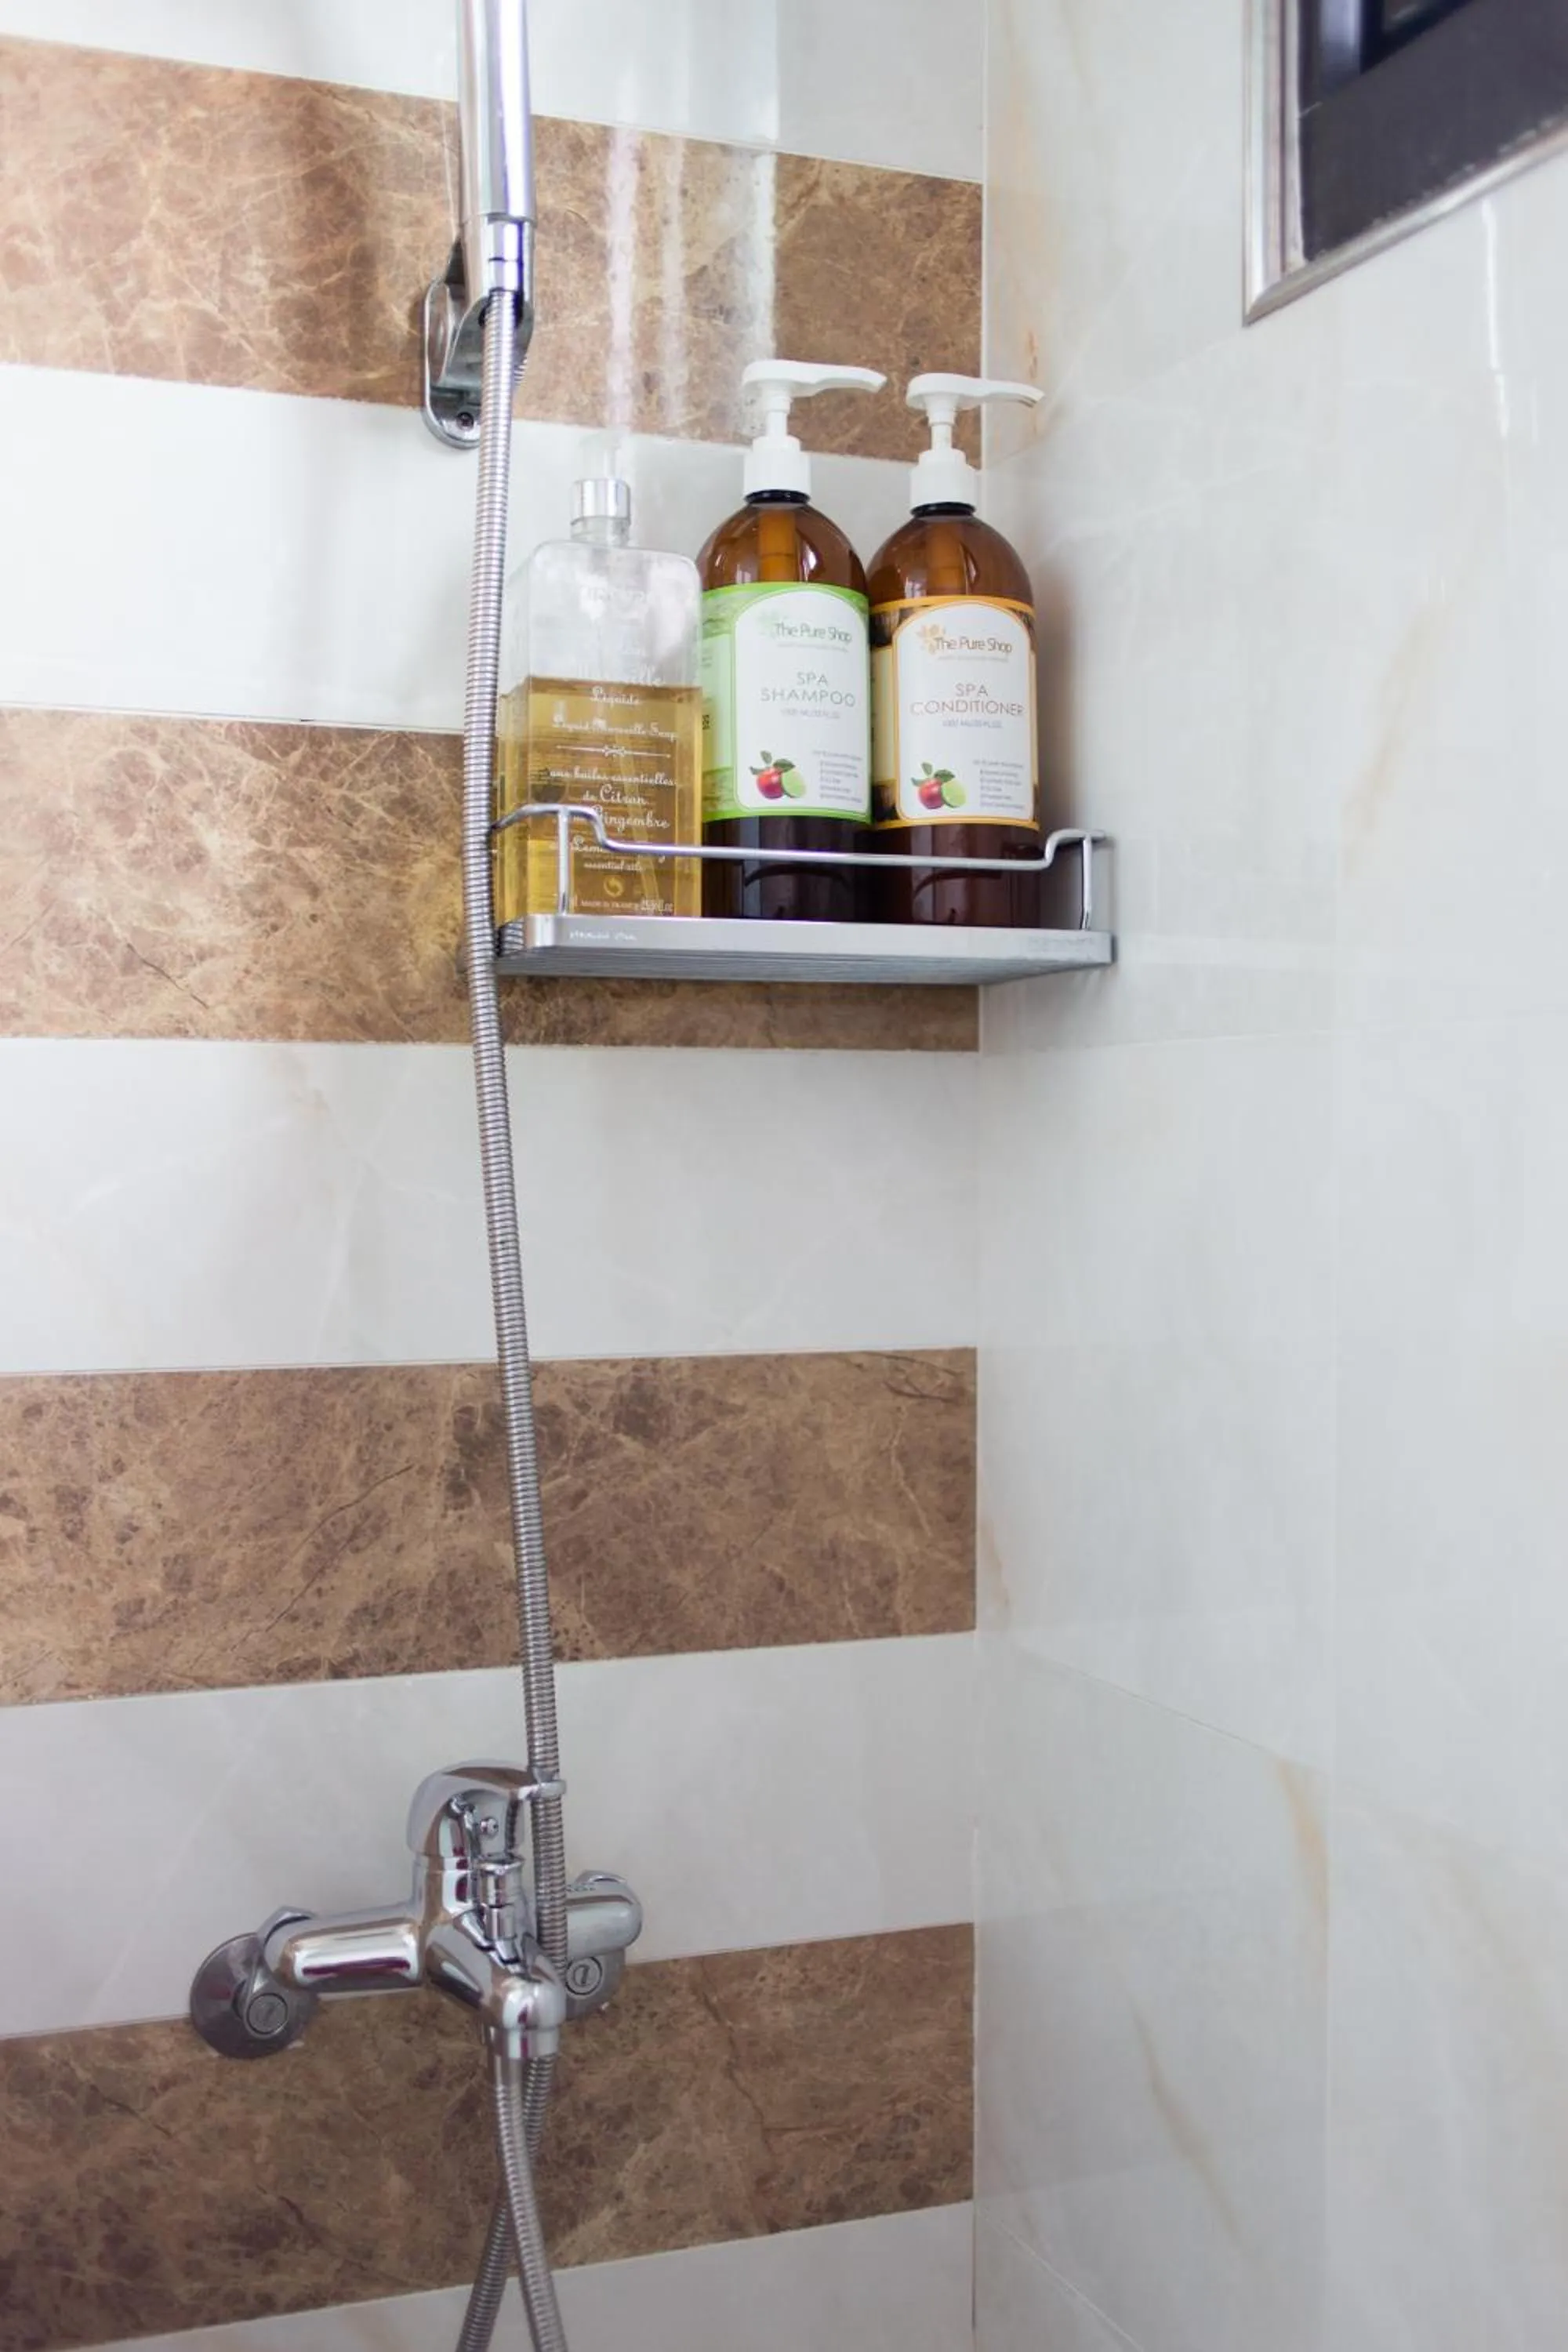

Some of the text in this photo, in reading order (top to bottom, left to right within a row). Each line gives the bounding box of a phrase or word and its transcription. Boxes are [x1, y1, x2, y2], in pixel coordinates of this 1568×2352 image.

[775, 622, 853, 645] The Pure Shop
[935, 636, 1013, 655] The Pure Shop
[797, 671, 828, 686] SPA
[760, 688, 855, 707] SHAMPOO
[955, 682, 989, 697] SPA
[909, 699, 1025, 717] CONDITIONER
[600, 783, 649, 805] Citron
[572, 835, 604, 852] Lem
